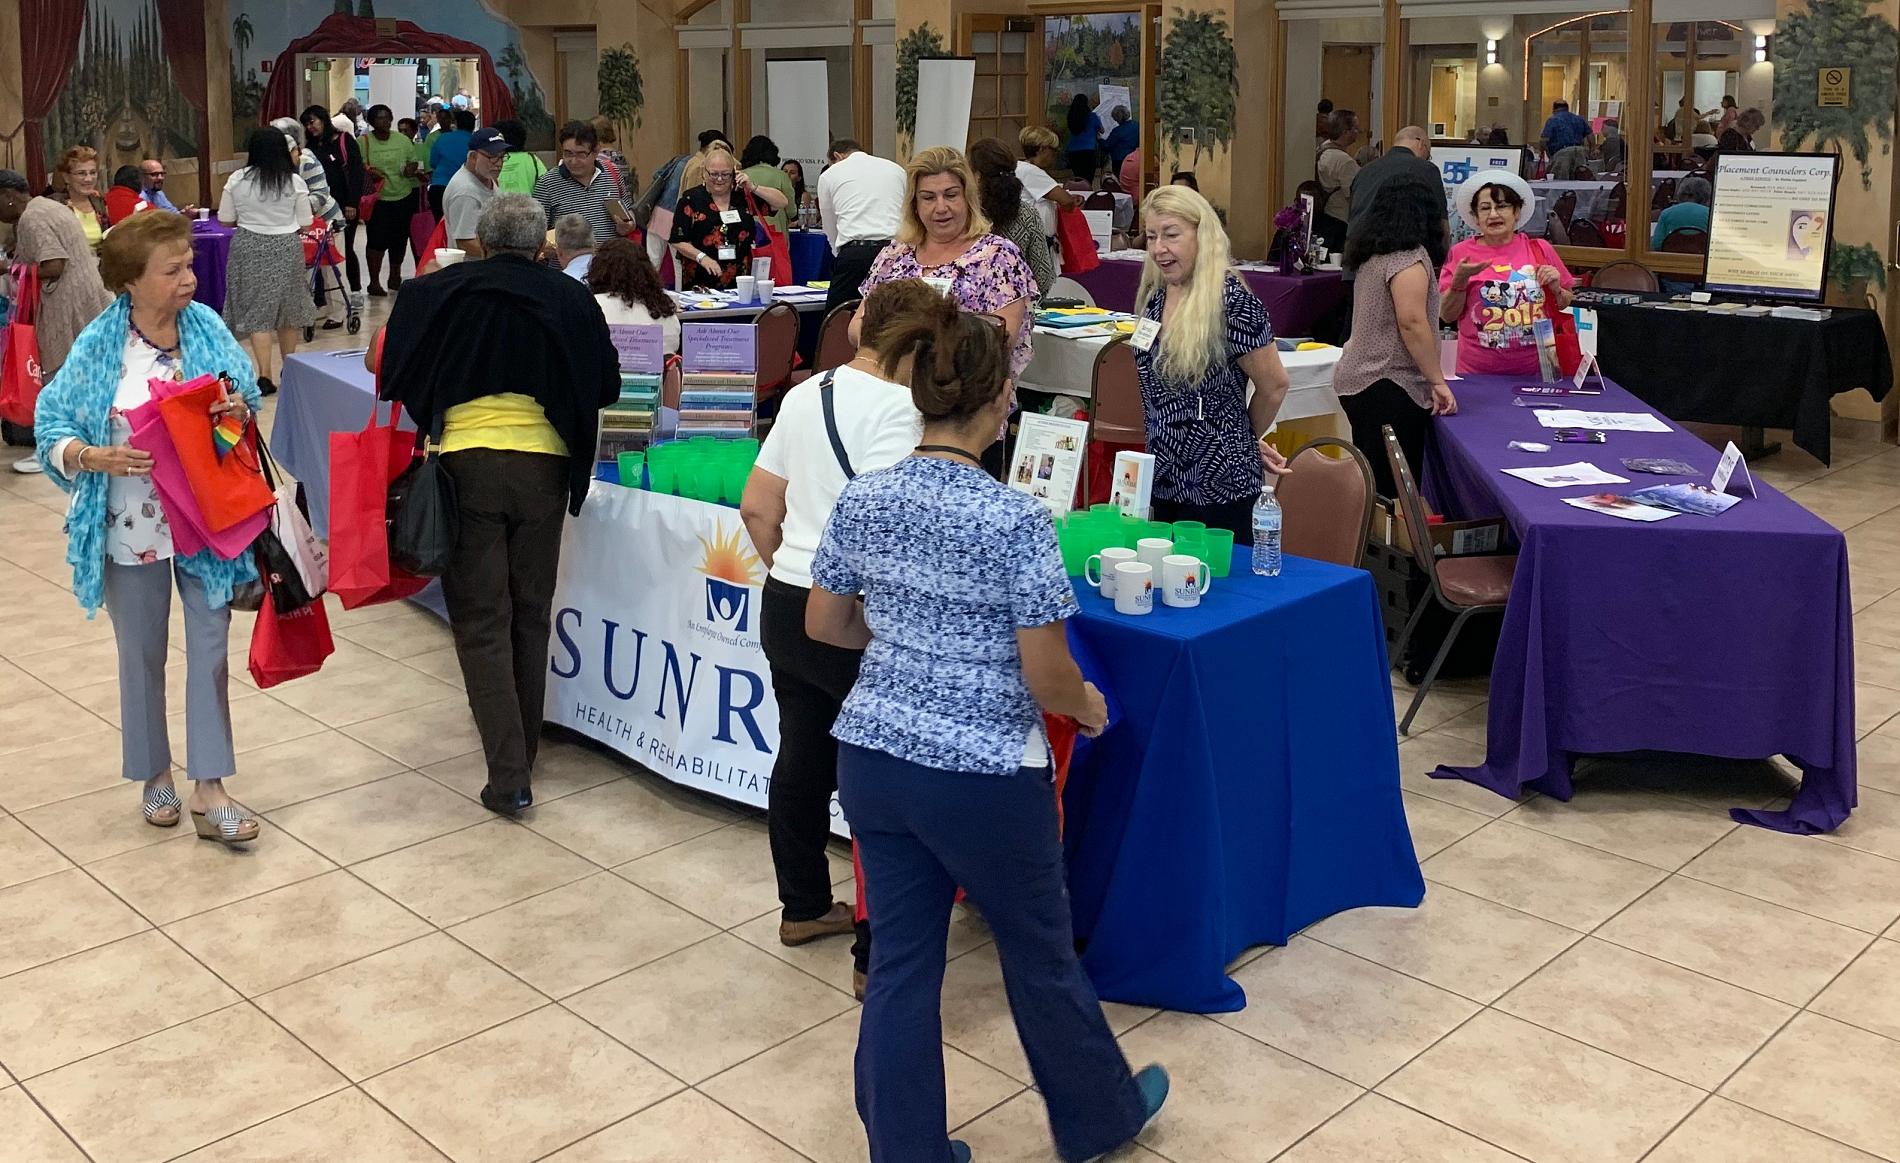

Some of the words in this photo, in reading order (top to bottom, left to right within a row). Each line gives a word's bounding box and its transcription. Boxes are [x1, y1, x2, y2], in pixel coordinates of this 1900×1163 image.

[1718, 165, 1760, 174] Placement
[1762, 166, 1807, 176] Counselors
[1808, 167, 1832, 180] Corp.
[1482, 302, 1544, 331] 2015
[717, 632, 741, 647] Owned
[550, 606, 772, 755] SUNR
[576, 702, 633, 742] HEALTH
[636, 731, 644, 748] &
